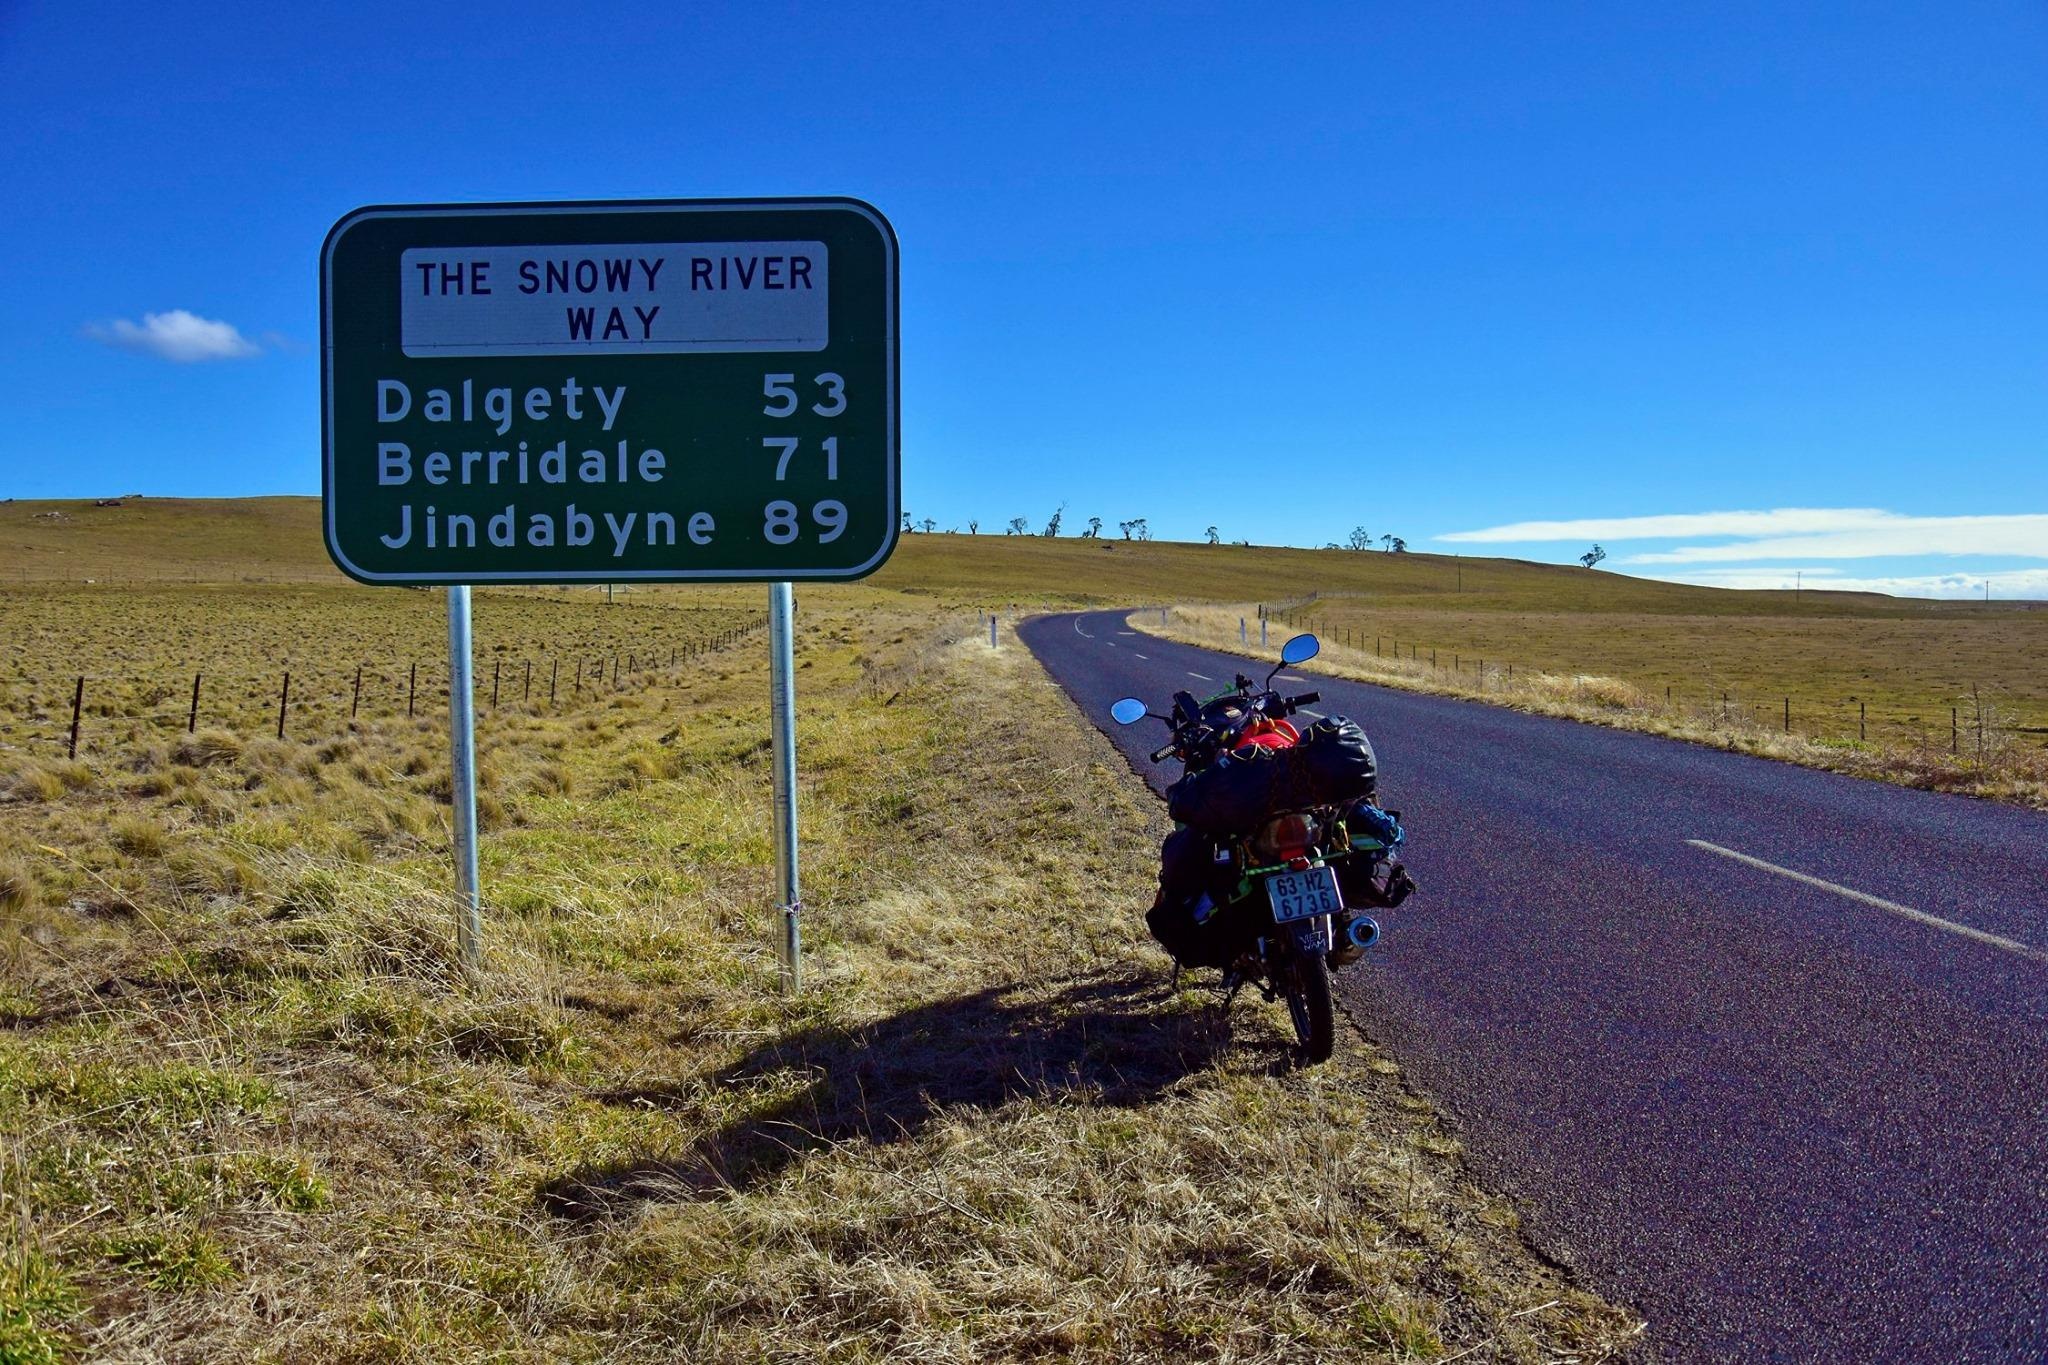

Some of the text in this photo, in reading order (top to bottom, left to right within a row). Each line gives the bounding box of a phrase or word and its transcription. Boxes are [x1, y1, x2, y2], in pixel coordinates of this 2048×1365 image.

[417, 256, 813, 295] THE SNOWY RIVER
[567, 306, 660, 340] WAY
[377, 372, 847, 436] Dalgety 53
[377, 436, 839, 486] Berridale 71
[379, 499, 848, 557] Jindabyne 89
[1281, 891, 1331, 917] 6736
[1299, 930, 1324, 944] VIET
[1303, 938, 1327, 951] NAM
